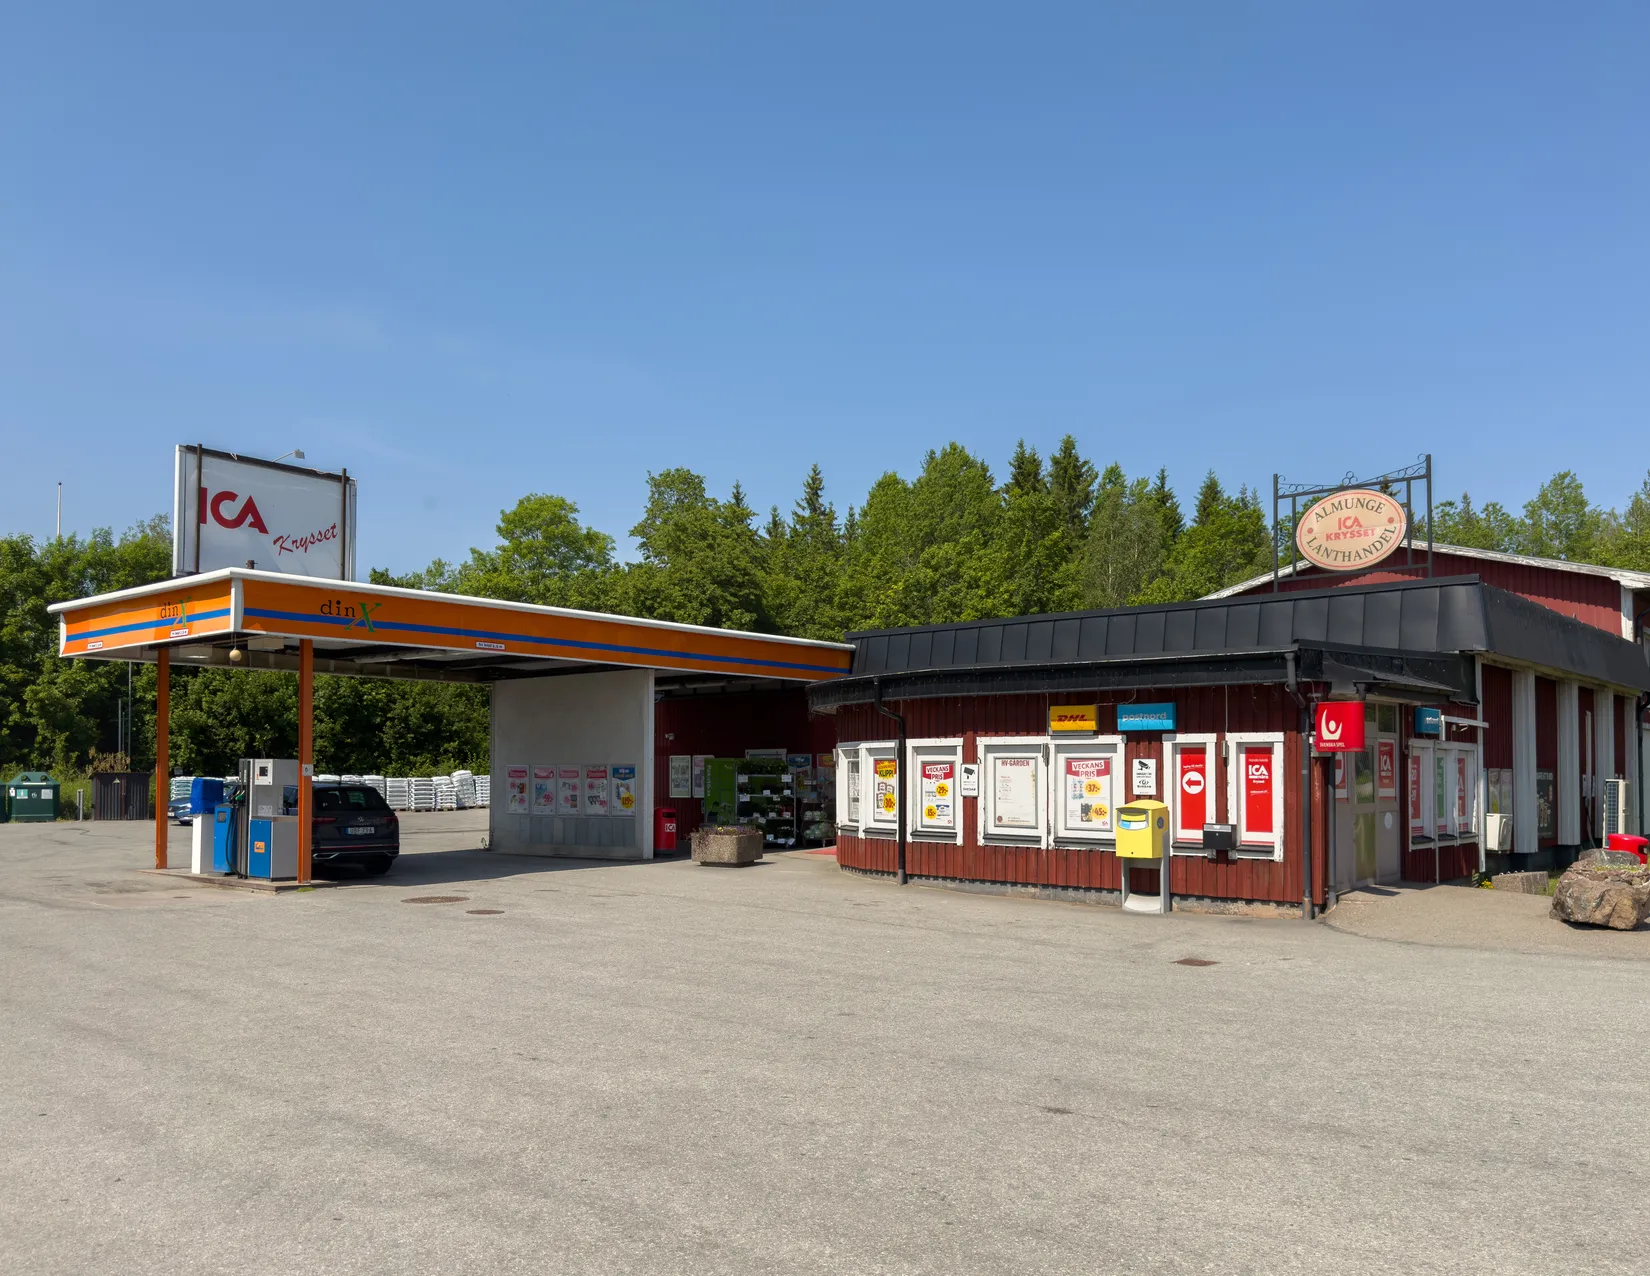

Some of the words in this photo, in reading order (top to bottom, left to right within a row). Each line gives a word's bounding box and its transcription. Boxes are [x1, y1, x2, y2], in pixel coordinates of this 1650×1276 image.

[200, 487, 269, 534] ICA
[1314, 497, 1386, 523] ALMUNGE
[1338, 516, 1363, 530] ICA
[273, 523, 338, 556] Krysset
[1325, 528, 1376, 542] KRYSSET
[1307, 526, 1397, 562] LANTHANDEL
[1057, 714, 1087, 722] DHL
[1122, 712, 1167, 722] postnord
[1072, 762, 1104, 770] VECKANS
[1248, 765, 1269, 775] ICA
[1380, 755, 1391, 771] ICA
